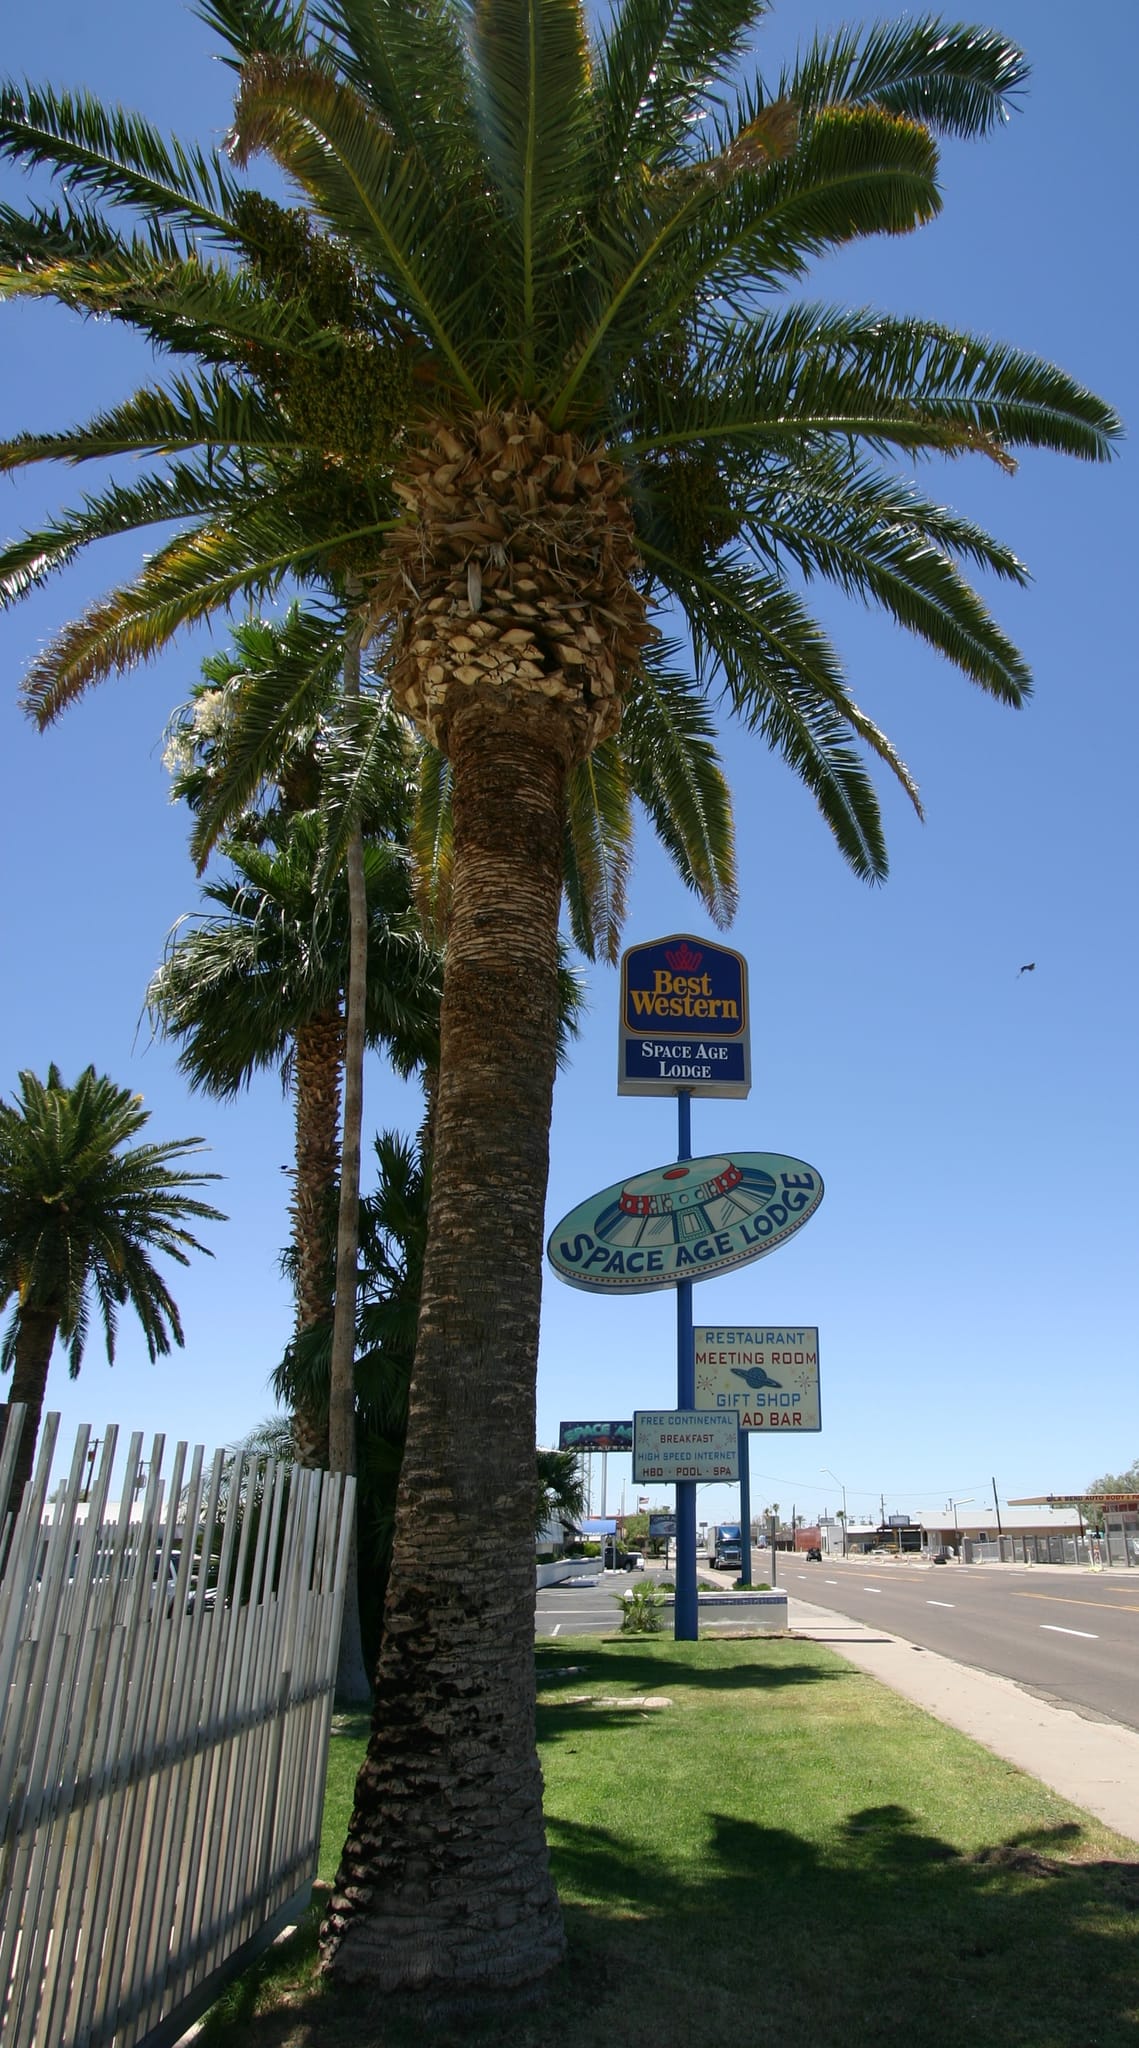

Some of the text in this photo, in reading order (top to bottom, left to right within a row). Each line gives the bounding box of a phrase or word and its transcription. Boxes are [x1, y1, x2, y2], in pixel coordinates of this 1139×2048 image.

[653, 970, 712, 996] Best
[630, 990, 739, 1019] Western
[641, 1041, 728, 1060] SPACE AGE
[659, 1061, 712, 1078] LODGE
[560, 1172, 815, 1274] SPACE AGE LODGE
[705, 1332, 805, 1344] RESTAURANT
[696, 1352, 817, 1365] MEETING ROOM
[716, 1393, 801, 1407] GIFT SHOP
[640, 1416, 733, 1425] FREE CONTINENTAL
[770, 1412, 802, 1426] BAR
[564, 1423, 632, 1442] SPACE AG
[660, 1434, 714, 1443] BREAKFAST
[638, 1451, 736, 1461] HIGH SPEED INTERNET
[642, 1467, 732, 1477] HBO POOL SPA
